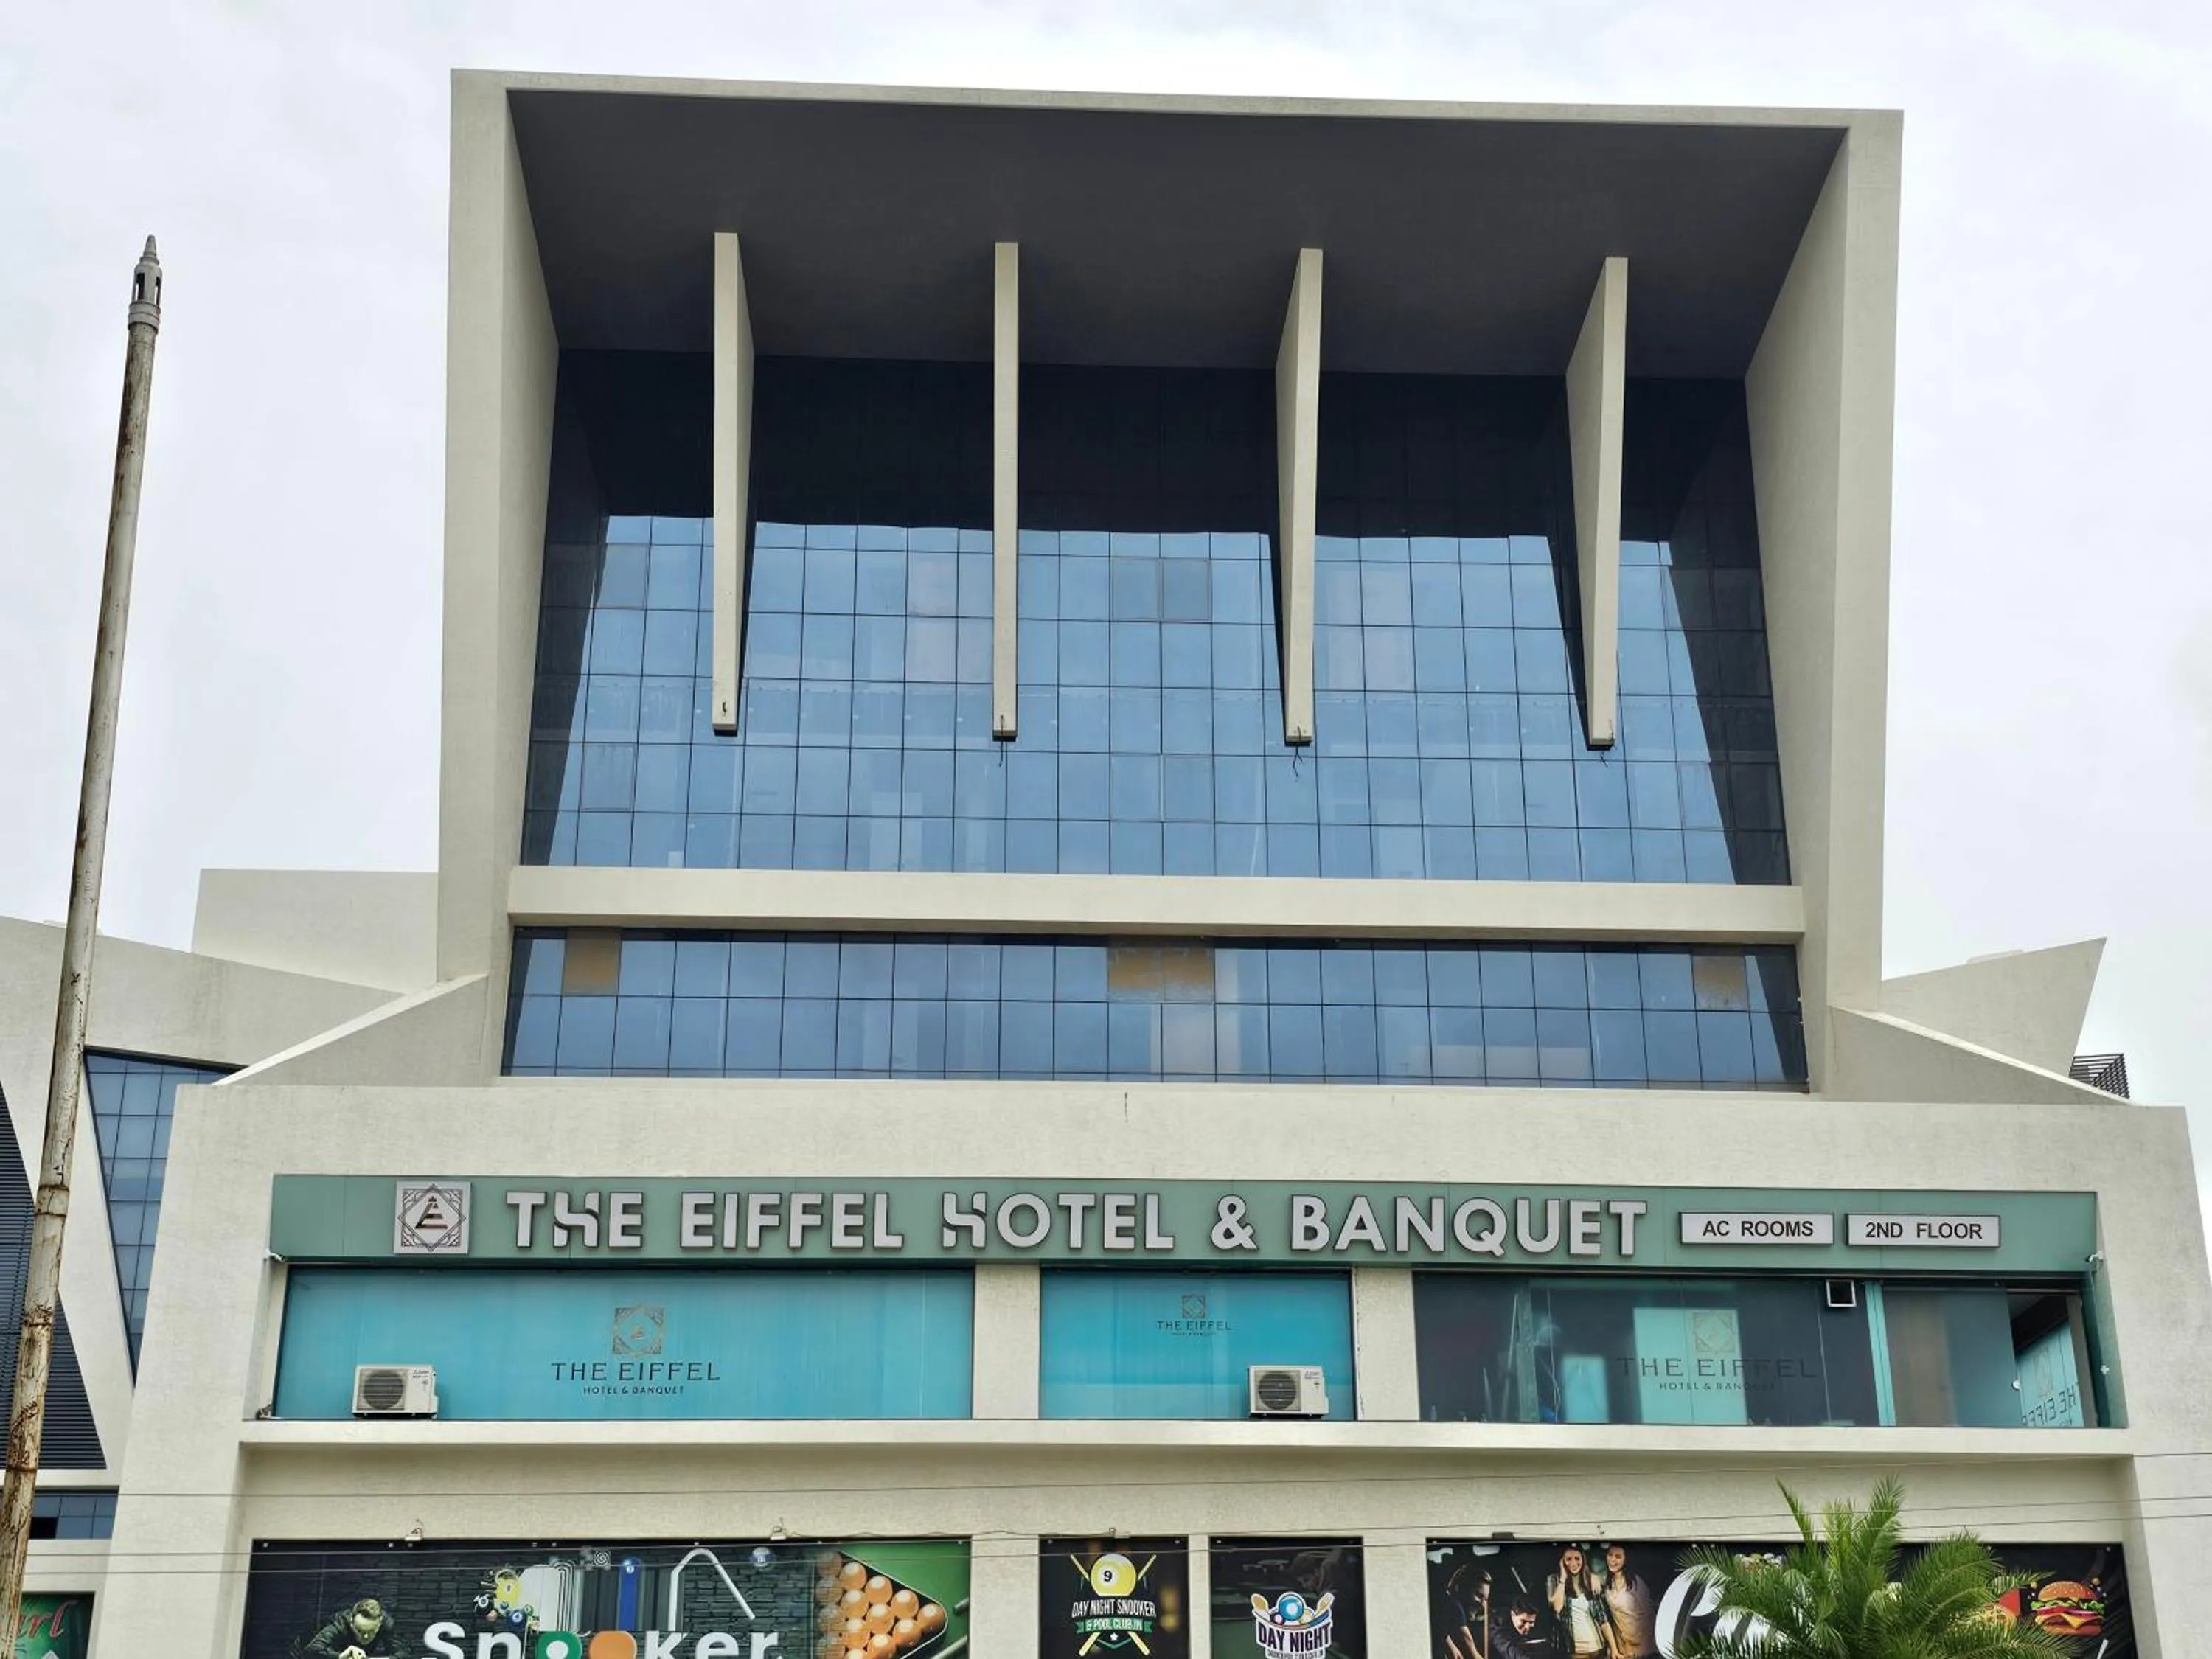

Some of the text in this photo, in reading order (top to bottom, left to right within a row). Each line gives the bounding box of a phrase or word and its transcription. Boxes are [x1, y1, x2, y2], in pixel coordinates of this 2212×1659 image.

[507, 1191, 1647, 1258] THE EIFFEL HOTEL & BANQUET
[1703, 1220, 1814, 1238] AC ROOMS
[1865, 1222, 1983, 1240] 2ND FLOOR
[1156, 1321, 1233, 1331] THE EIFFEL
[552, 1362, 720, 1381] THE EIFFEL
[1615, 1357, 1818, 1378] THE EIFFEL
[583, 1386, 684, 1395] HOTEL & BANQUET
[1659, 1382, 1699, 1391] HOTEL
[1103, 1570, 1113, 1582] 9
[1071, 1598, 1157, 1618] DAY NIGHT SNOOKER
[1259, 1621, 1331, 1652] DAY NIGHT
